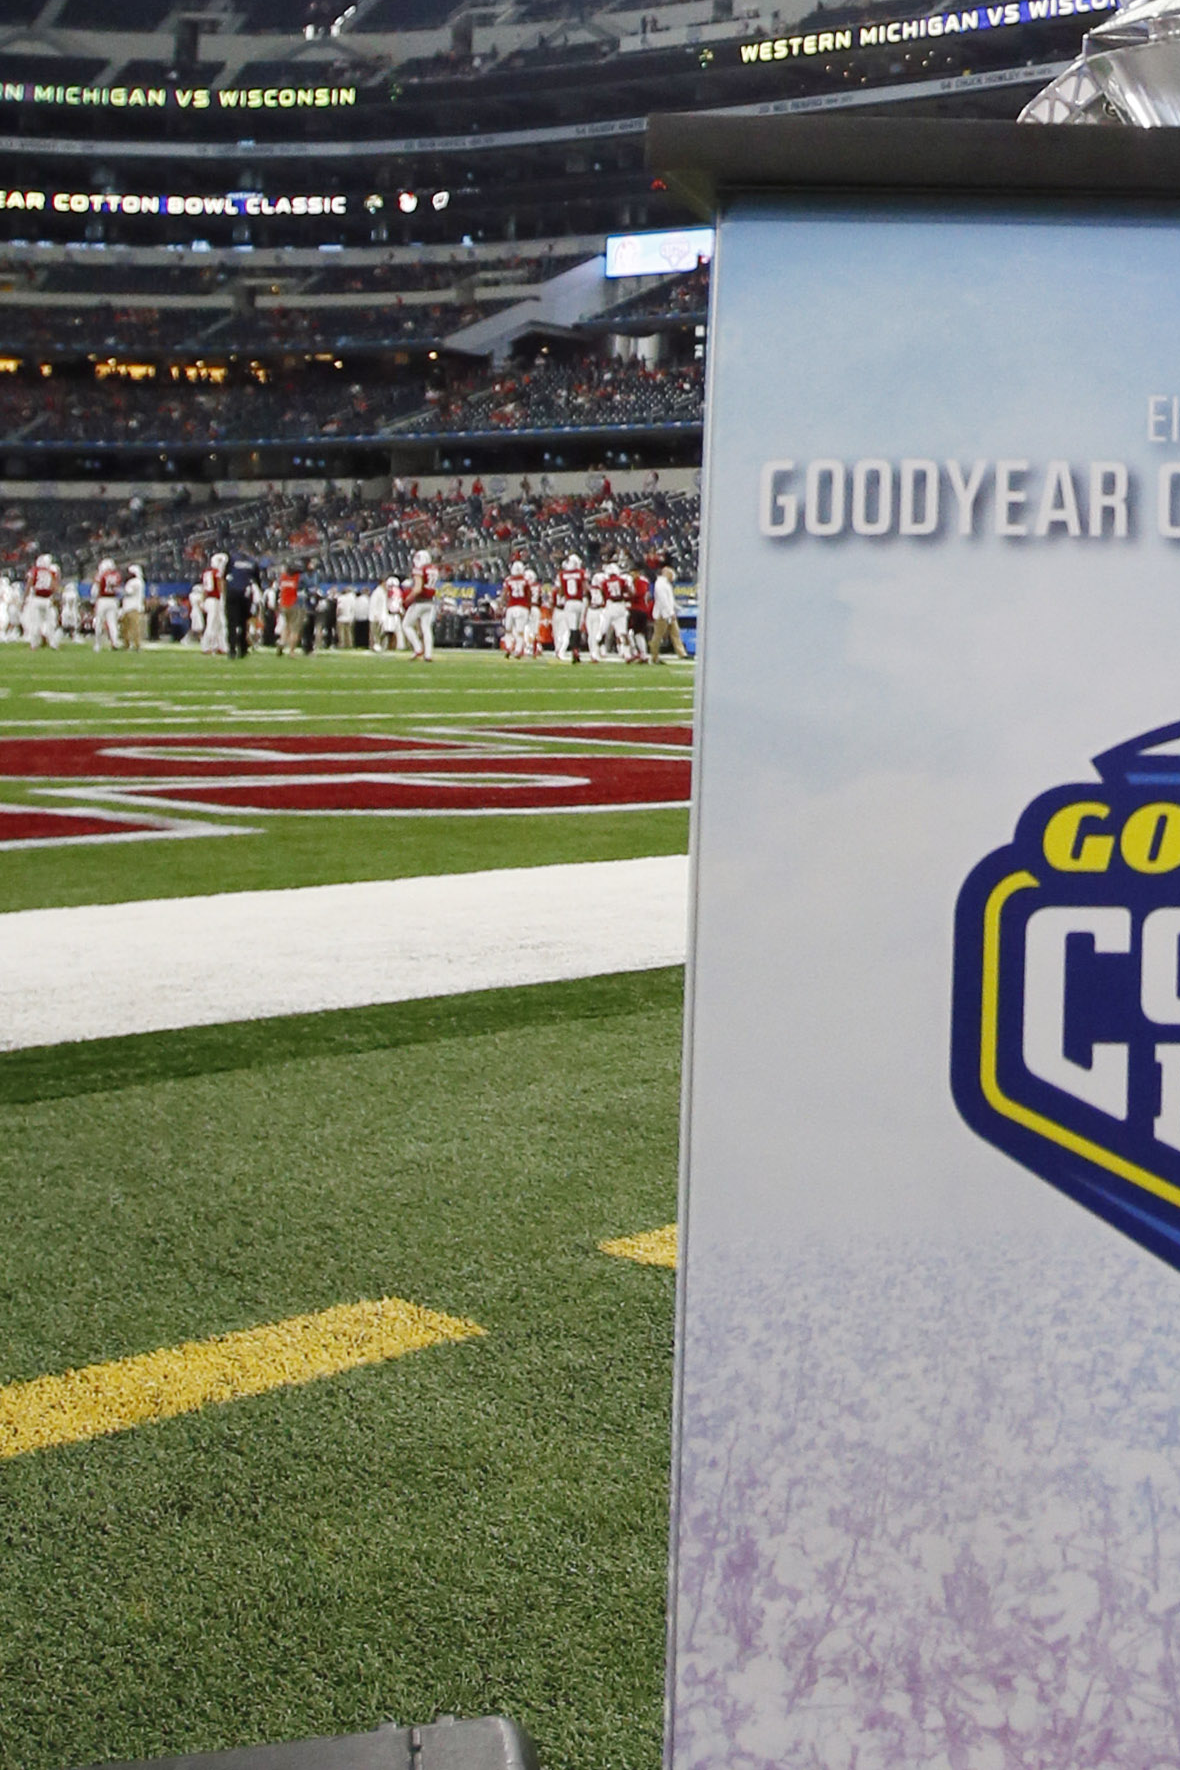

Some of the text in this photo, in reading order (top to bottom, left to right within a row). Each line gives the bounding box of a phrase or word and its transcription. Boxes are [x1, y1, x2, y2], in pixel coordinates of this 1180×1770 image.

[740, 30, 852, 63] WESTERN
[860, 11, 979, 46] MICHIGAN
[988, 5, 1021, 26] VS
[34, 84, 167, 108] MICHIGAN
[175, 88, 211, 109] VS
[218, 87, 357, 109] WISCONSIN
[53, 192, 160, 215] COTTON
[167, 194, 239, 215] BOWL
[246, 196, 348, 215] CLASSIC
[760, 458, 1131, 540] GOODYEAR
